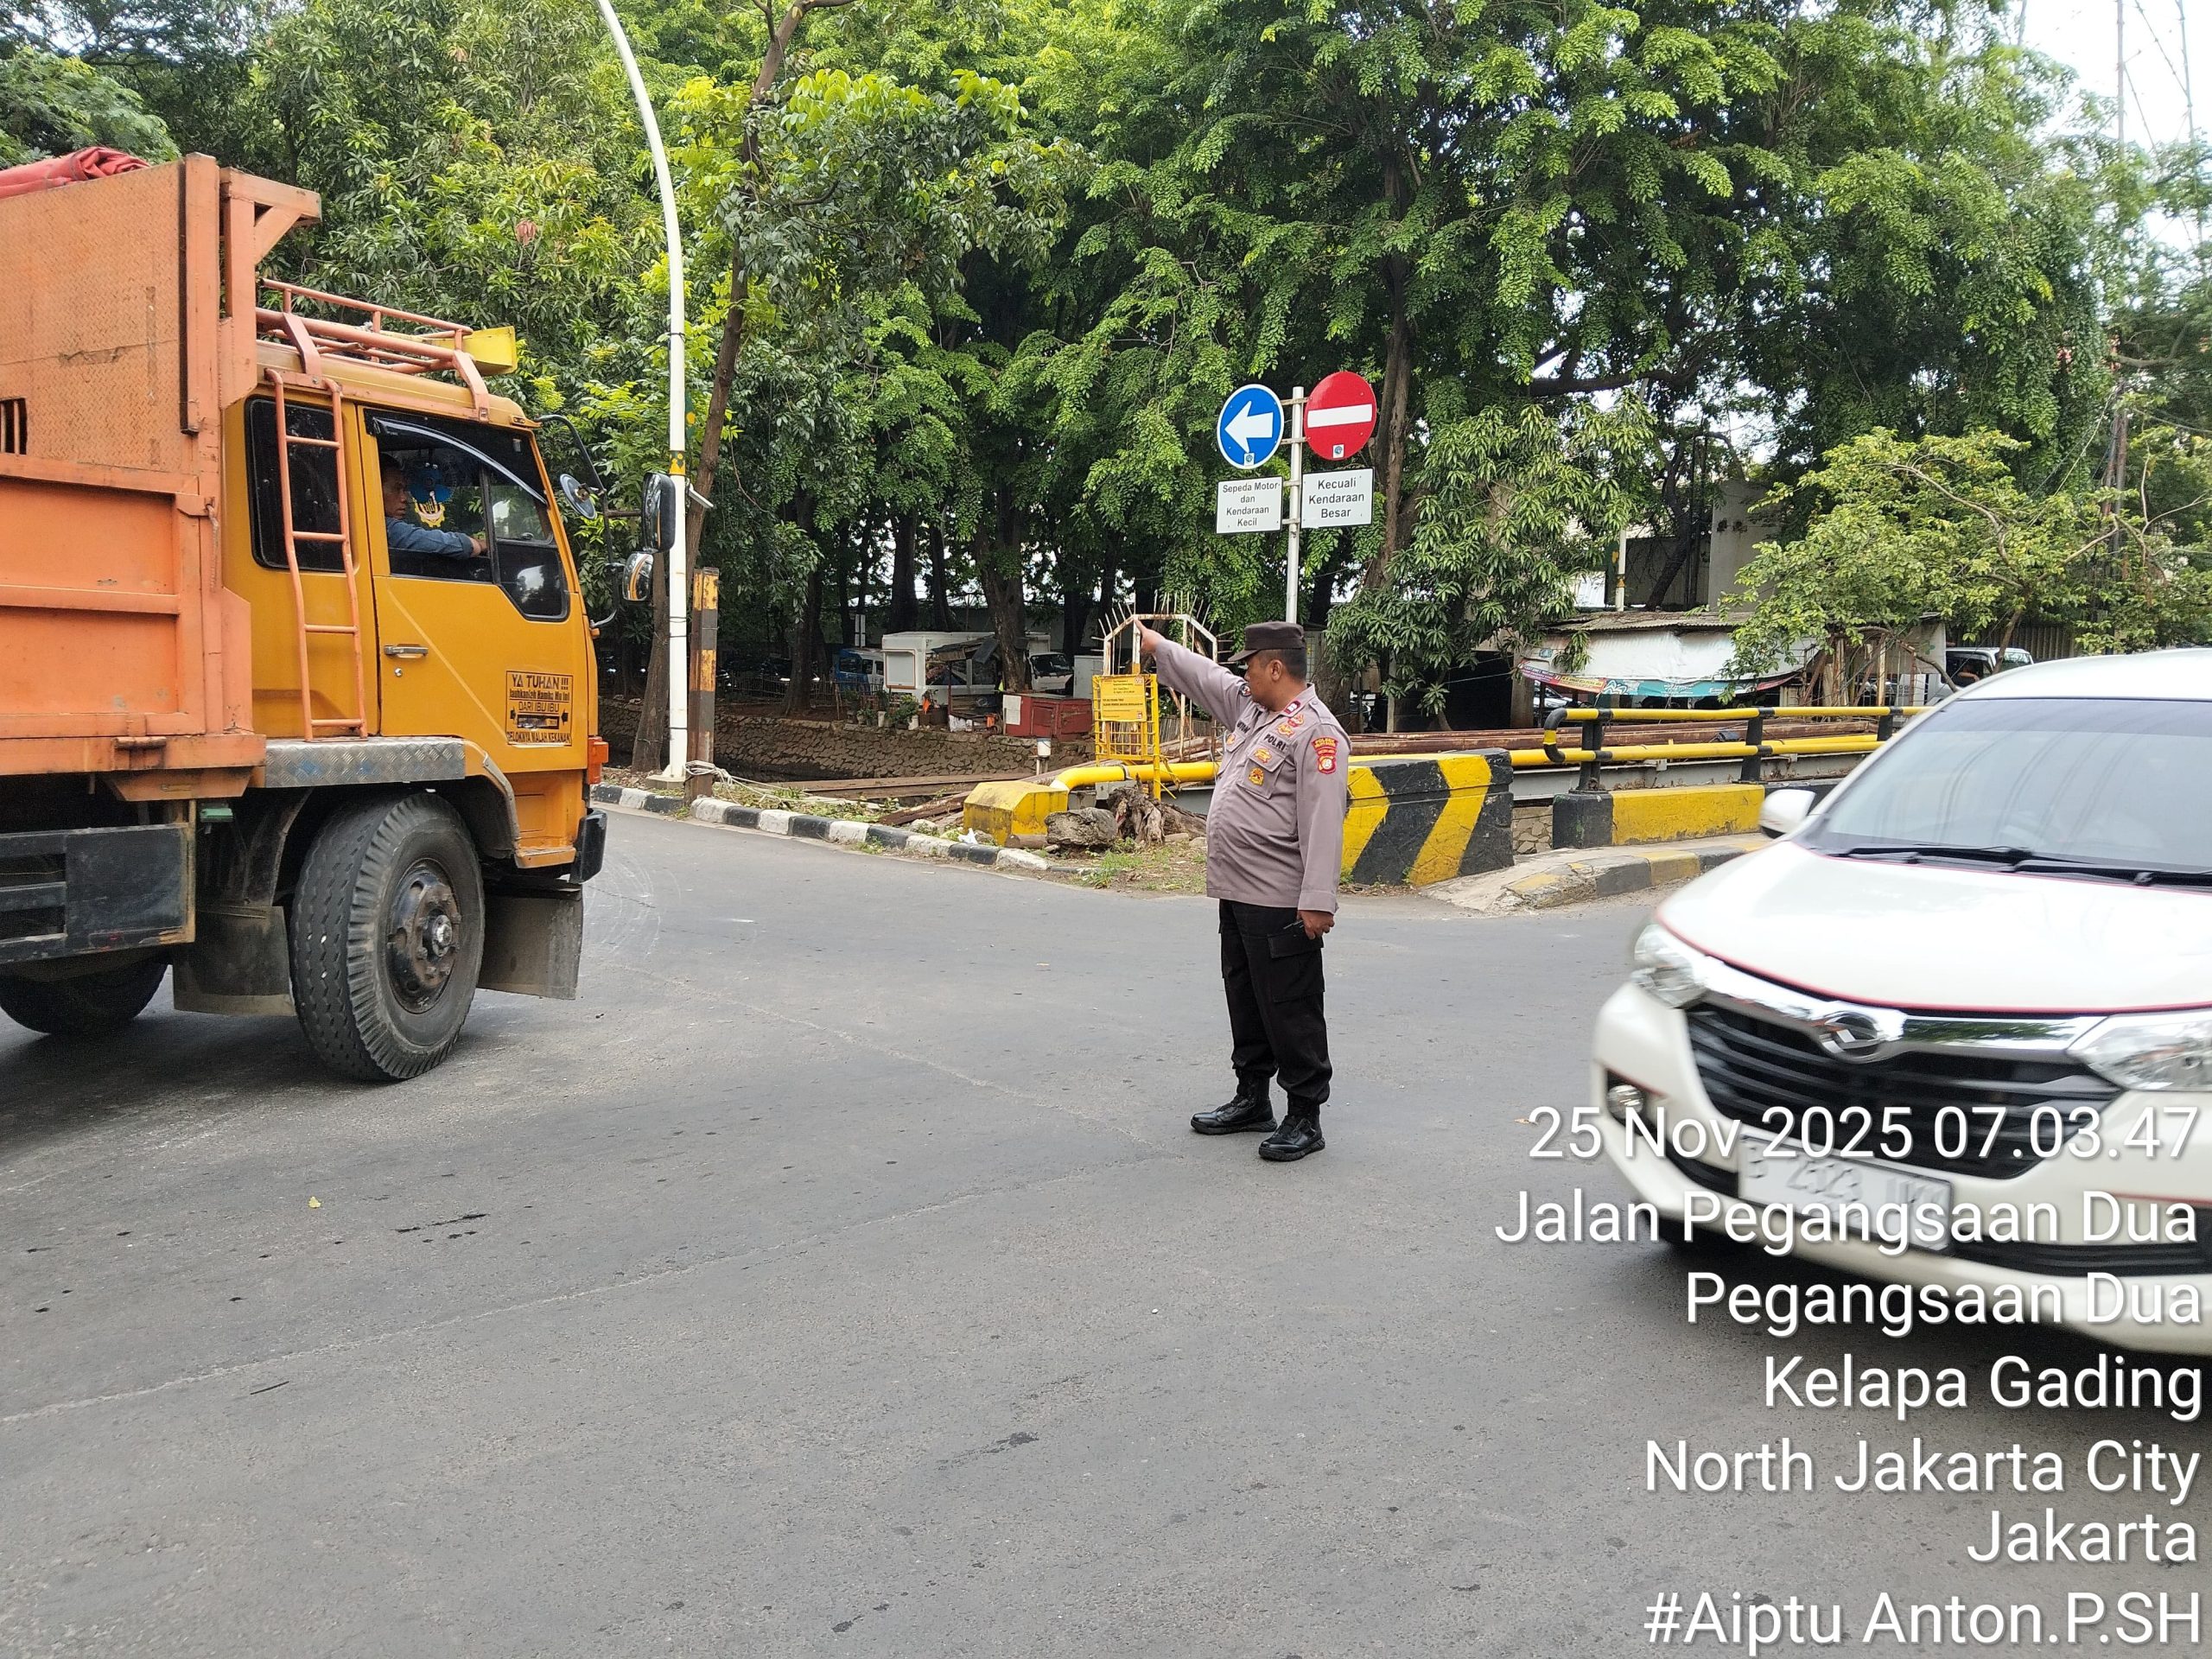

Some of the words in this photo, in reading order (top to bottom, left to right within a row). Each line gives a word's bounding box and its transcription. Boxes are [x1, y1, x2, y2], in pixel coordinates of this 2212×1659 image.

[1223, 483, 1253, 494] Sepeda
[1254, 481, 1279, 491] Motor
[1318, 477, 1357, 490] Kecuali
[1240, 494, 1255, 504] dan
[1309, 493, 1364, 505] Kendaraan
[1226, 506, 1269, 516] Kendaraan
[1320, 507, 1351, 518] Besar
[1236, 517, 1258, 526] Kecil
[512, 674, 524, 687] YA
[526, 676, 560, 690] TUHAN
[518, 701, 534, 711] DARI
[534, 702, 547, 712] IBU
[547, 702, 560, 713] IBU
[1264, 734, 1287, 751] POLRI
